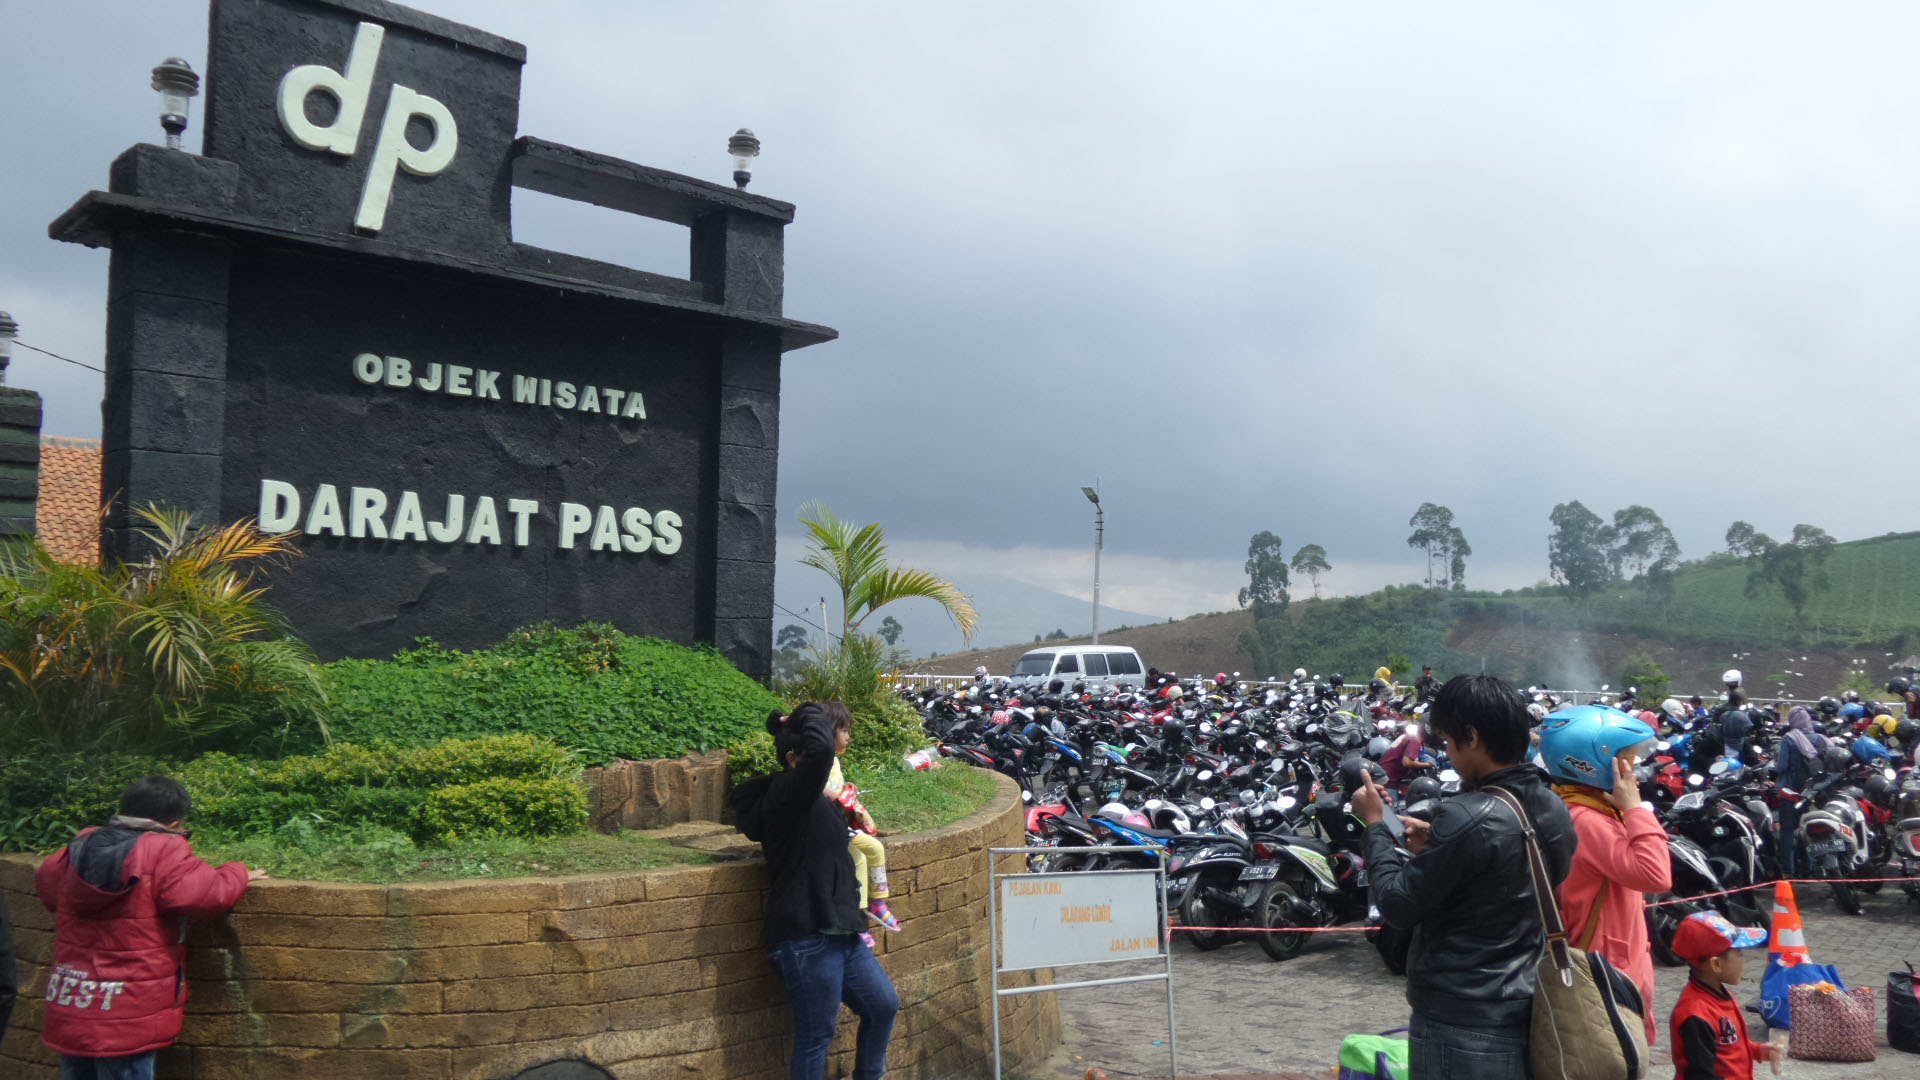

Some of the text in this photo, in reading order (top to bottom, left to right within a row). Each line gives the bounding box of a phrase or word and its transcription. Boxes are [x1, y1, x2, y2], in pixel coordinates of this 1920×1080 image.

[277, 22, 459, 231] dp
[353, 353, 648, 420] OBJEK WISATA
[257, 479, 683, 555] DARAJAT PASS
[1009, 881, 1062, 897] PEJALAN KAKI
[1109, 936, 1157, 952] JALAN INI
[46, 973, 125, 1011] BEST
